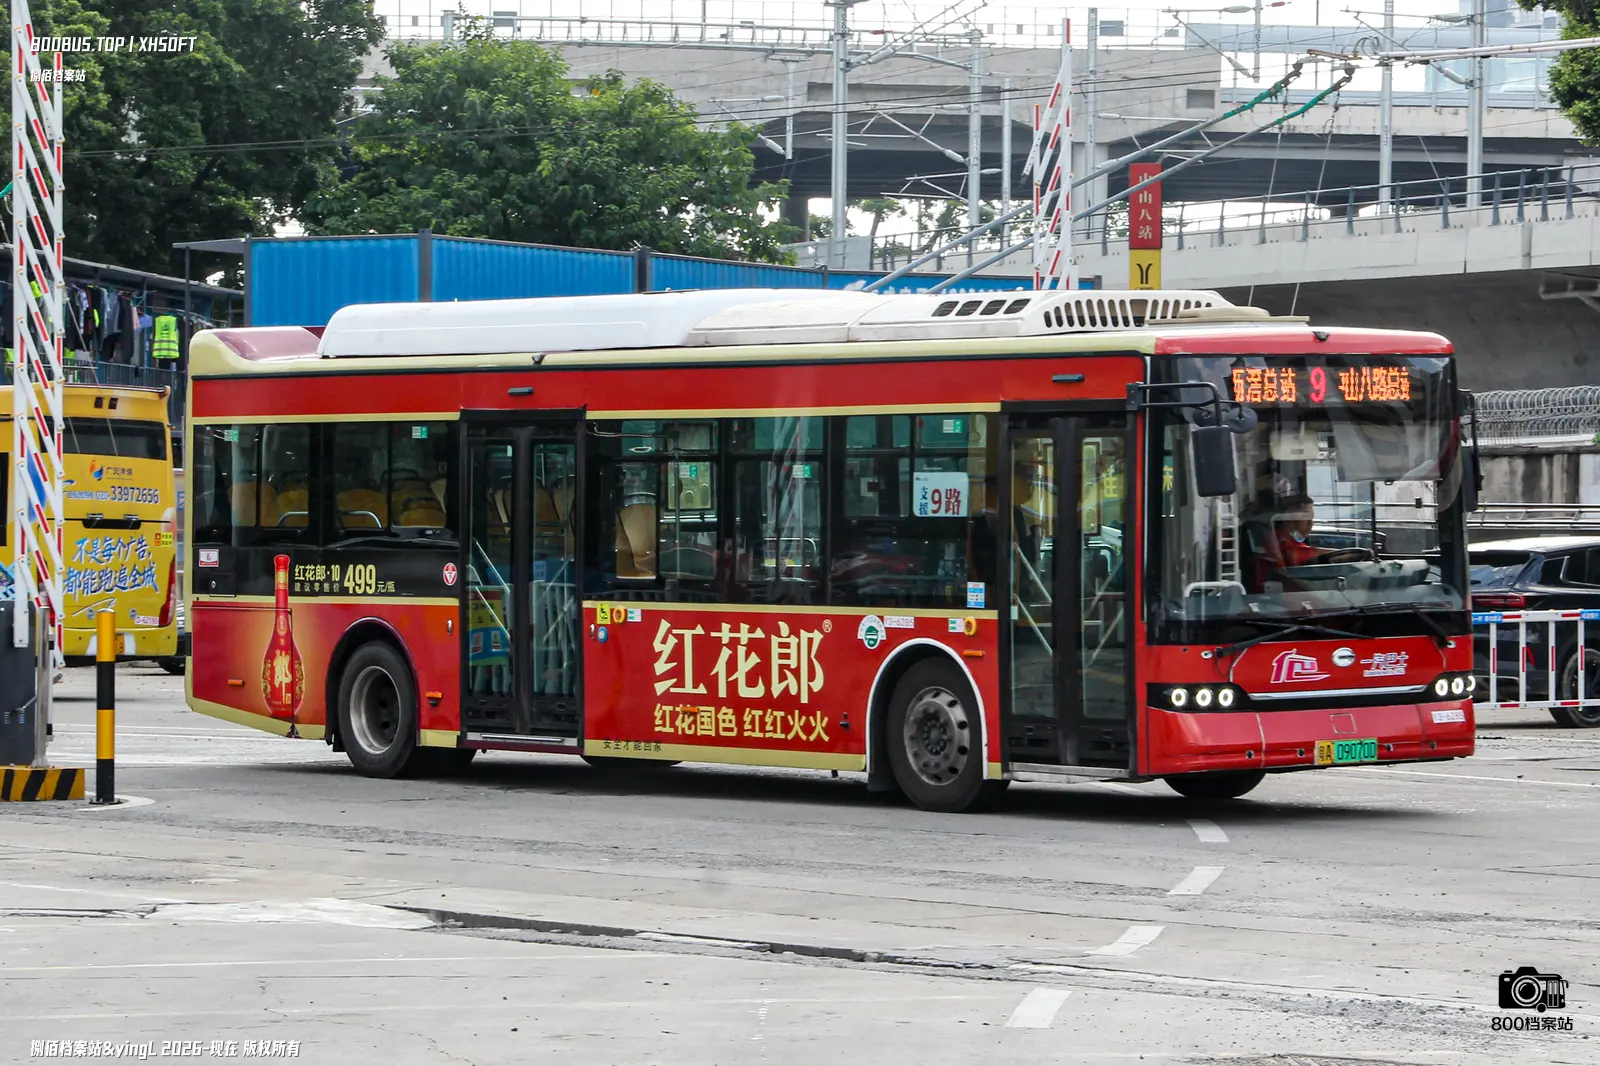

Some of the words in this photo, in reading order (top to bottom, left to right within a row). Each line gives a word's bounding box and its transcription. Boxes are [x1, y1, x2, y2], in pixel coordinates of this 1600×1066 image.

[1310, 367, 1326, 403] 9
[652, 618, 825, 704] 红花郎
[654, 703, 738, 737] 红花国色
[743, 707, 830, 742] 红红火火
[603, 737, 662, 752] 安全才能回家
